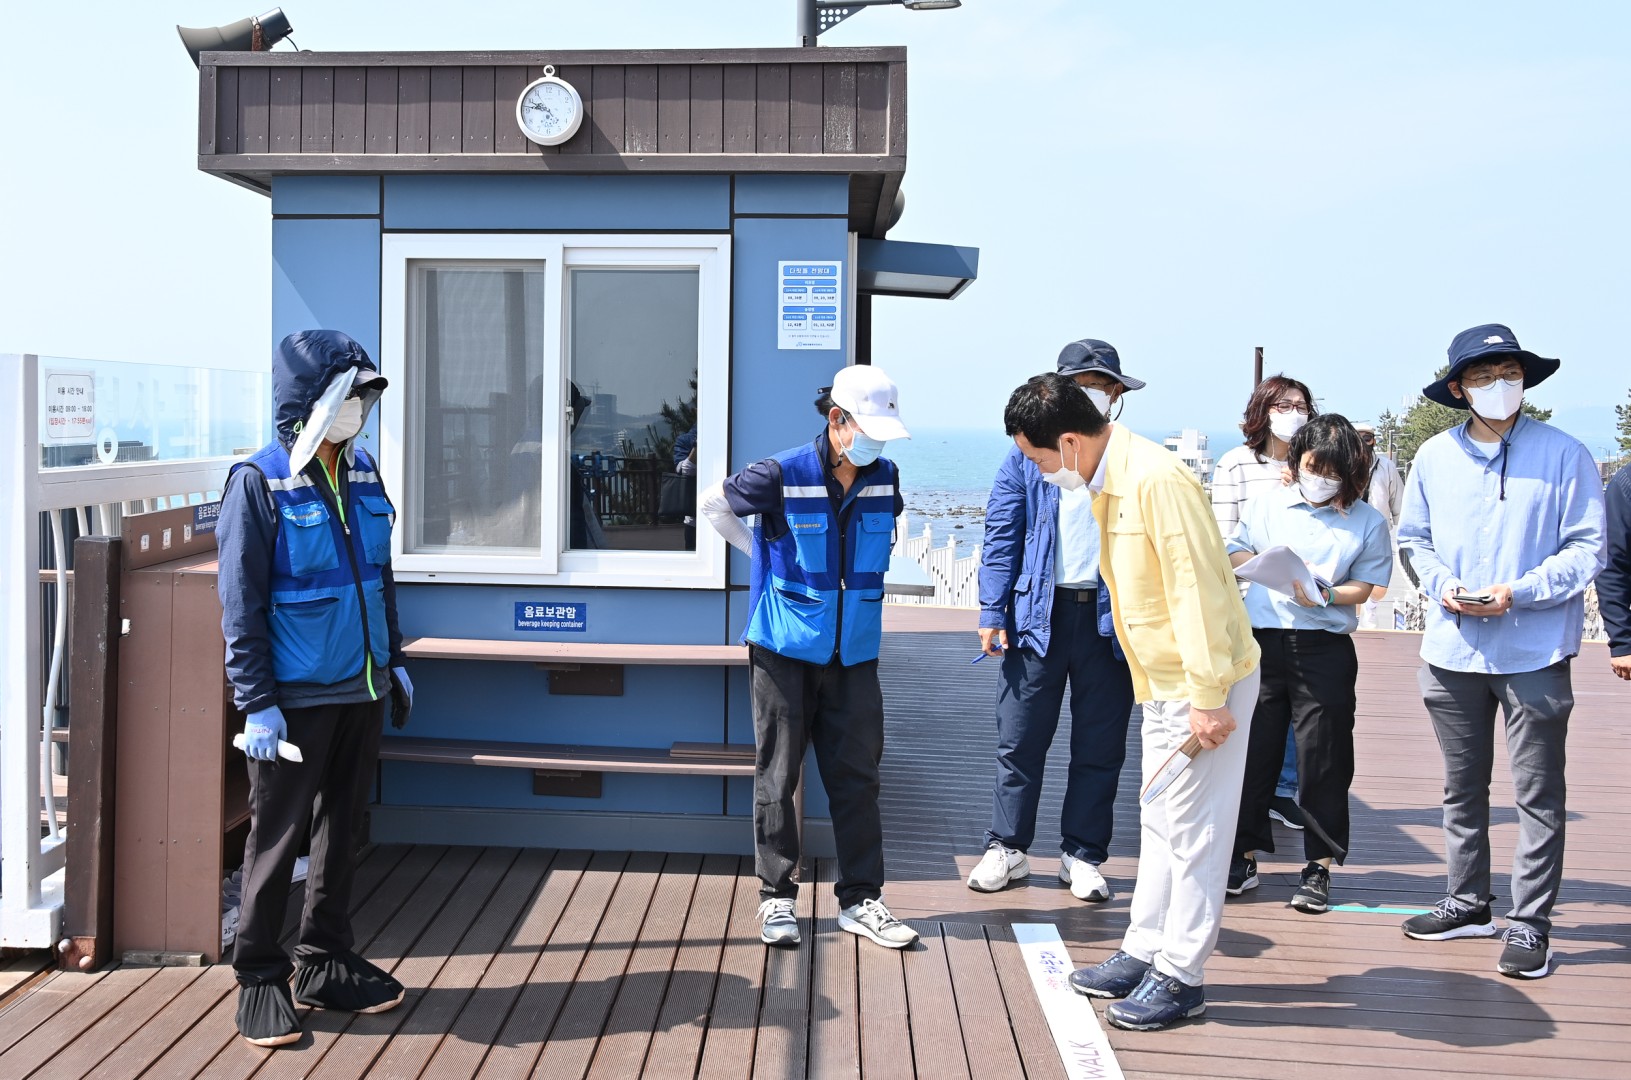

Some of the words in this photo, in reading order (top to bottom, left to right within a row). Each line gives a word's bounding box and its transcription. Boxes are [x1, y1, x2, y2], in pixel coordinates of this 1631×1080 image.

[67, 387, 75, 395] 시간
[76, 387, 84, 395] 안내
[524, 605, 576, 618] 음료보관함
[518, 619, 540, 628] beverage
[541, 619, 560, 628] keeping
[561, 619, 583, 628] container
[1068, 1040, 1107, 1080] WALK
